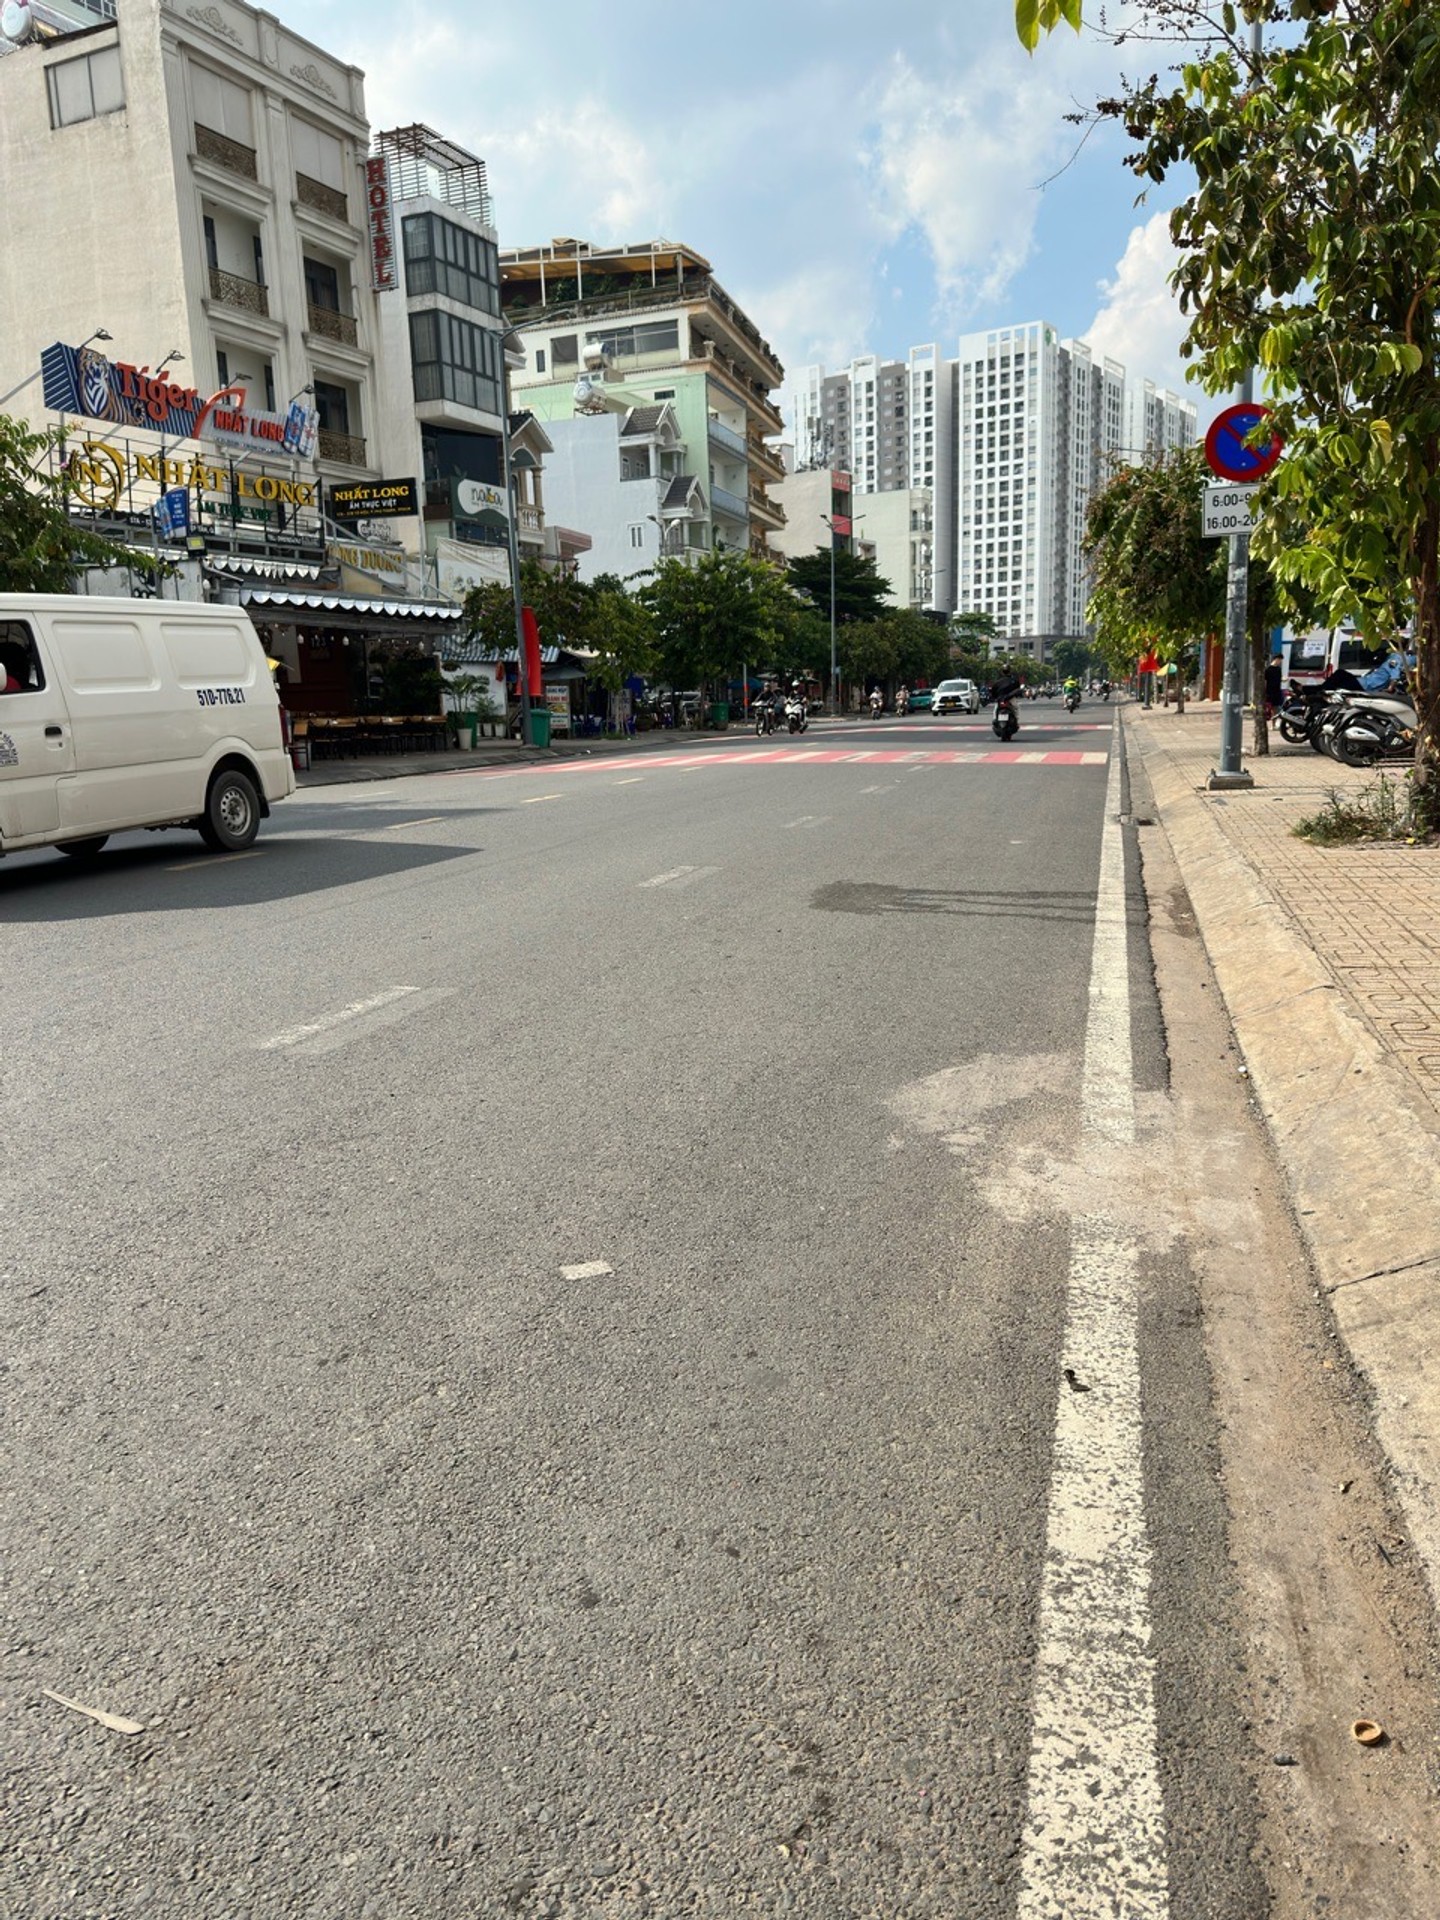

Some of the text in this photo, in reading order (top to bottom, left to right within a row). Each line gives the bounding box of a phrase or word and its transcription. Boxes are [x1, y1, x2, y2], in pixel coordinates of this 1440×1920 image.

[366, 156, 393, 285] HOTEL
[116, 361, 198, 422] Tiger
[250, 418, 285, 444] LONG
[235, 471, 315, 506] LONG
[334, 484, 409, 501] NHẤT LONG
